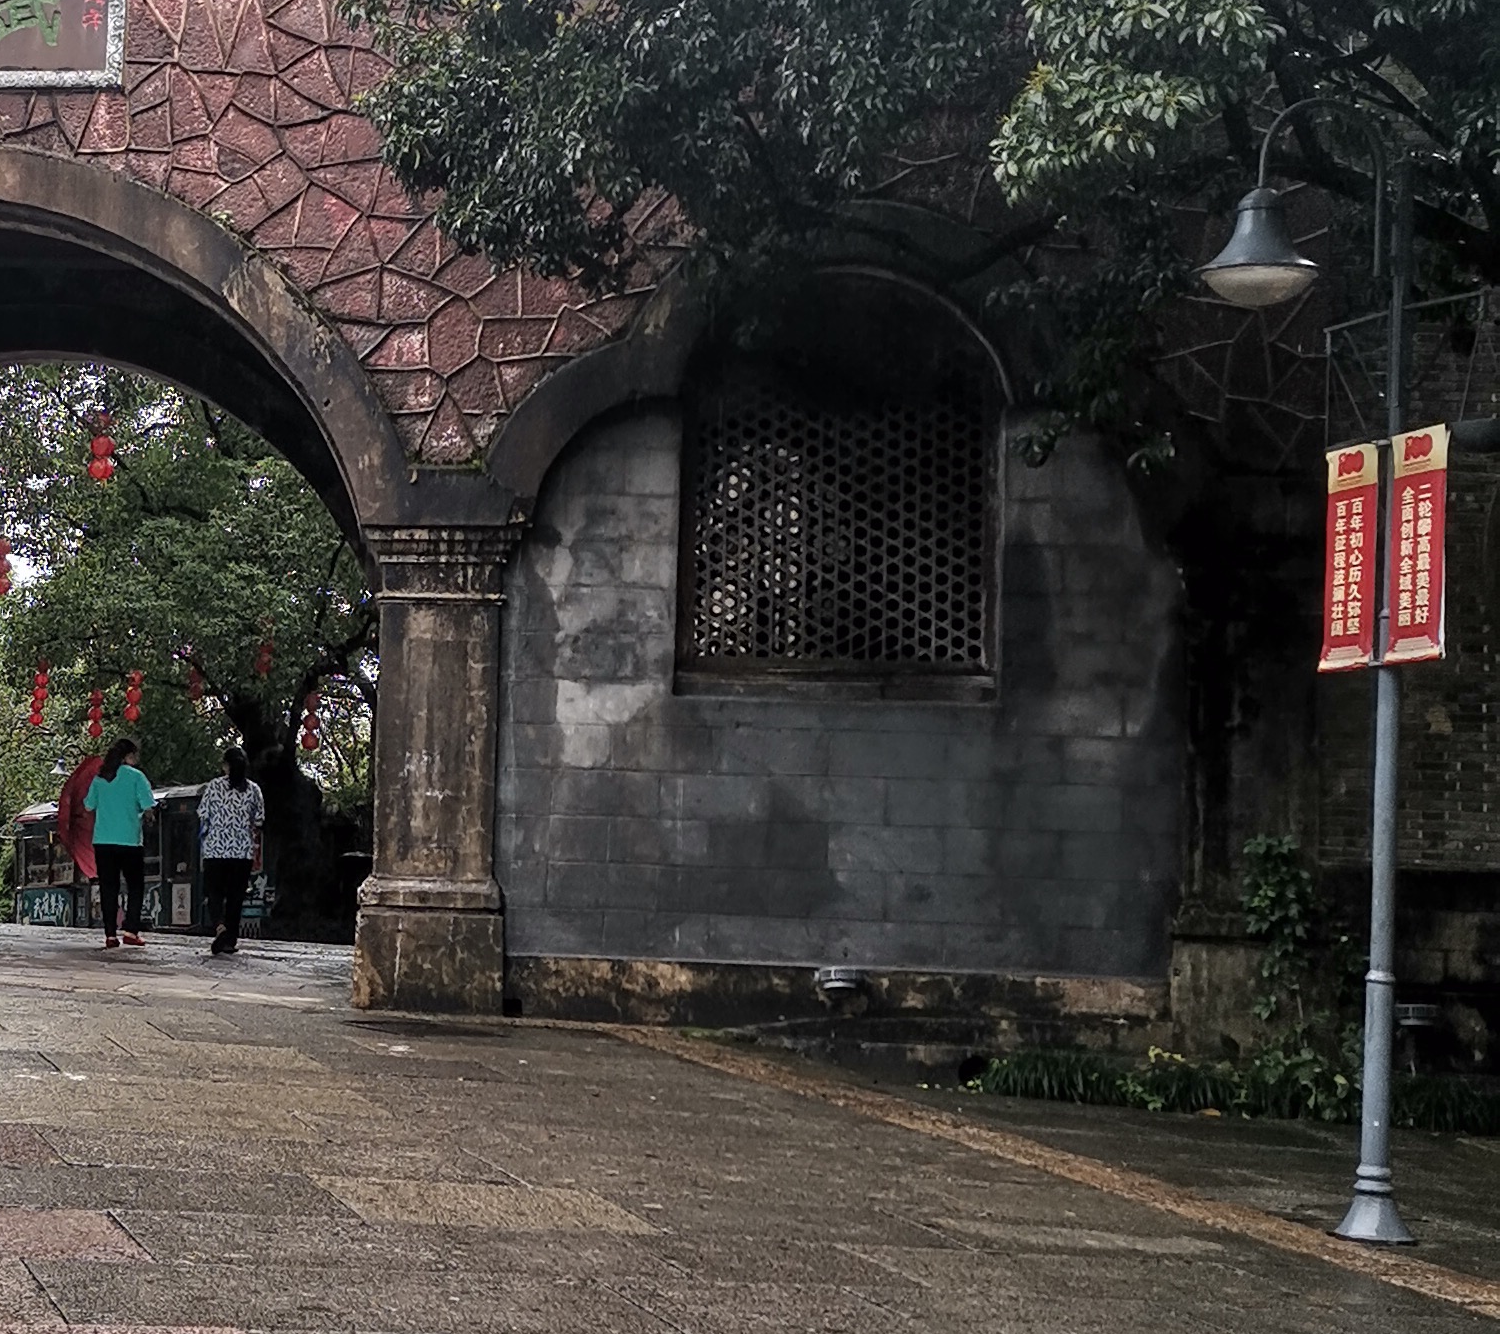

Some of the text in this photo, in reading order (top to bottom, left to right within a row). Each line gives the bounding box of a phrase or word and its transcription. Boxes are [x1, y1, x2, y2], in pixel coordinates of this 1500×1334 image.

[1330, 500, 1350, 637] 百年征程波澜壮阔
[1345, 497, 1365, 635] 百年初心历久弥坚
